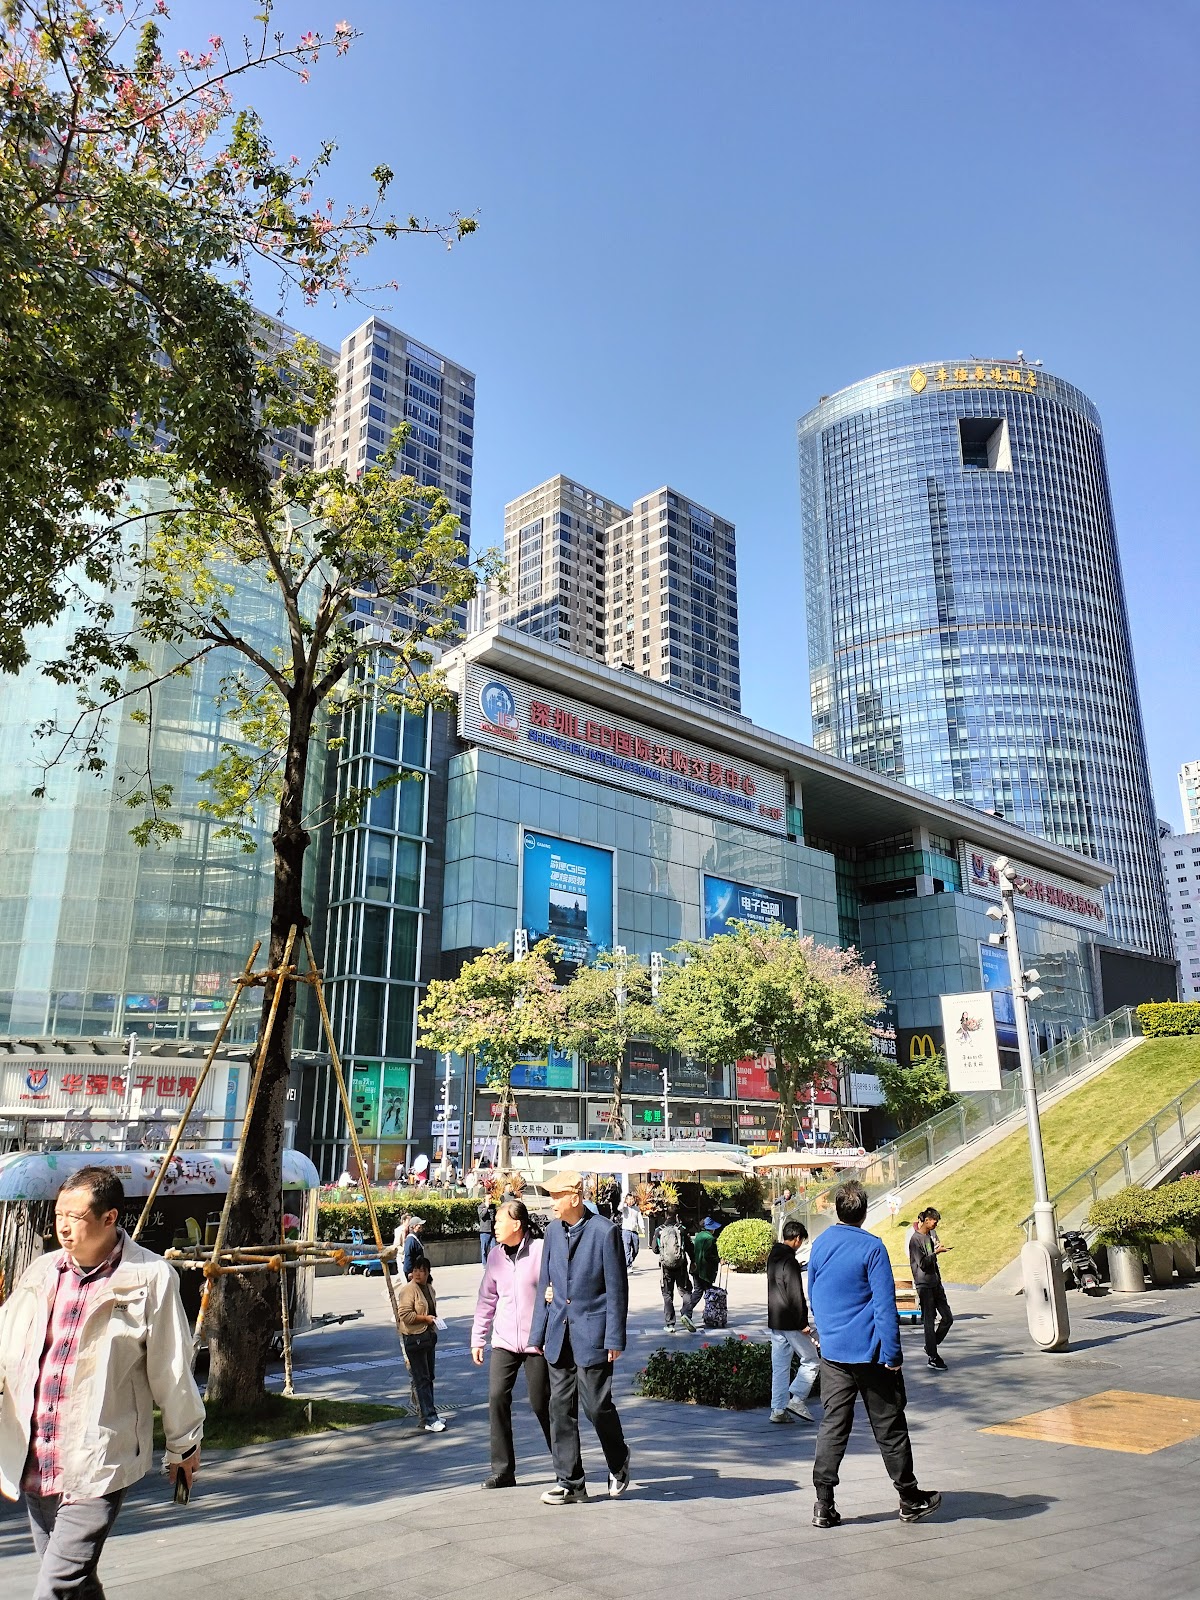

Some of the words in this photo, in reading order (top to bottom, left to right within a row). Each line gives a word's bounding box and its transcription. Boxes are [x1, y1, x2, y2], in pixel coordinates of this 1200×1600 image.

[530, 700, 757, 796] 深圳LED国际采购交易中心
[741, 896, 780, 917] 电子总部
[736, 1066, 753, 1075] anon
[60, 1073, 198, 1098] 华强电子世界
[117, 1211, 165, 1228] 松光
